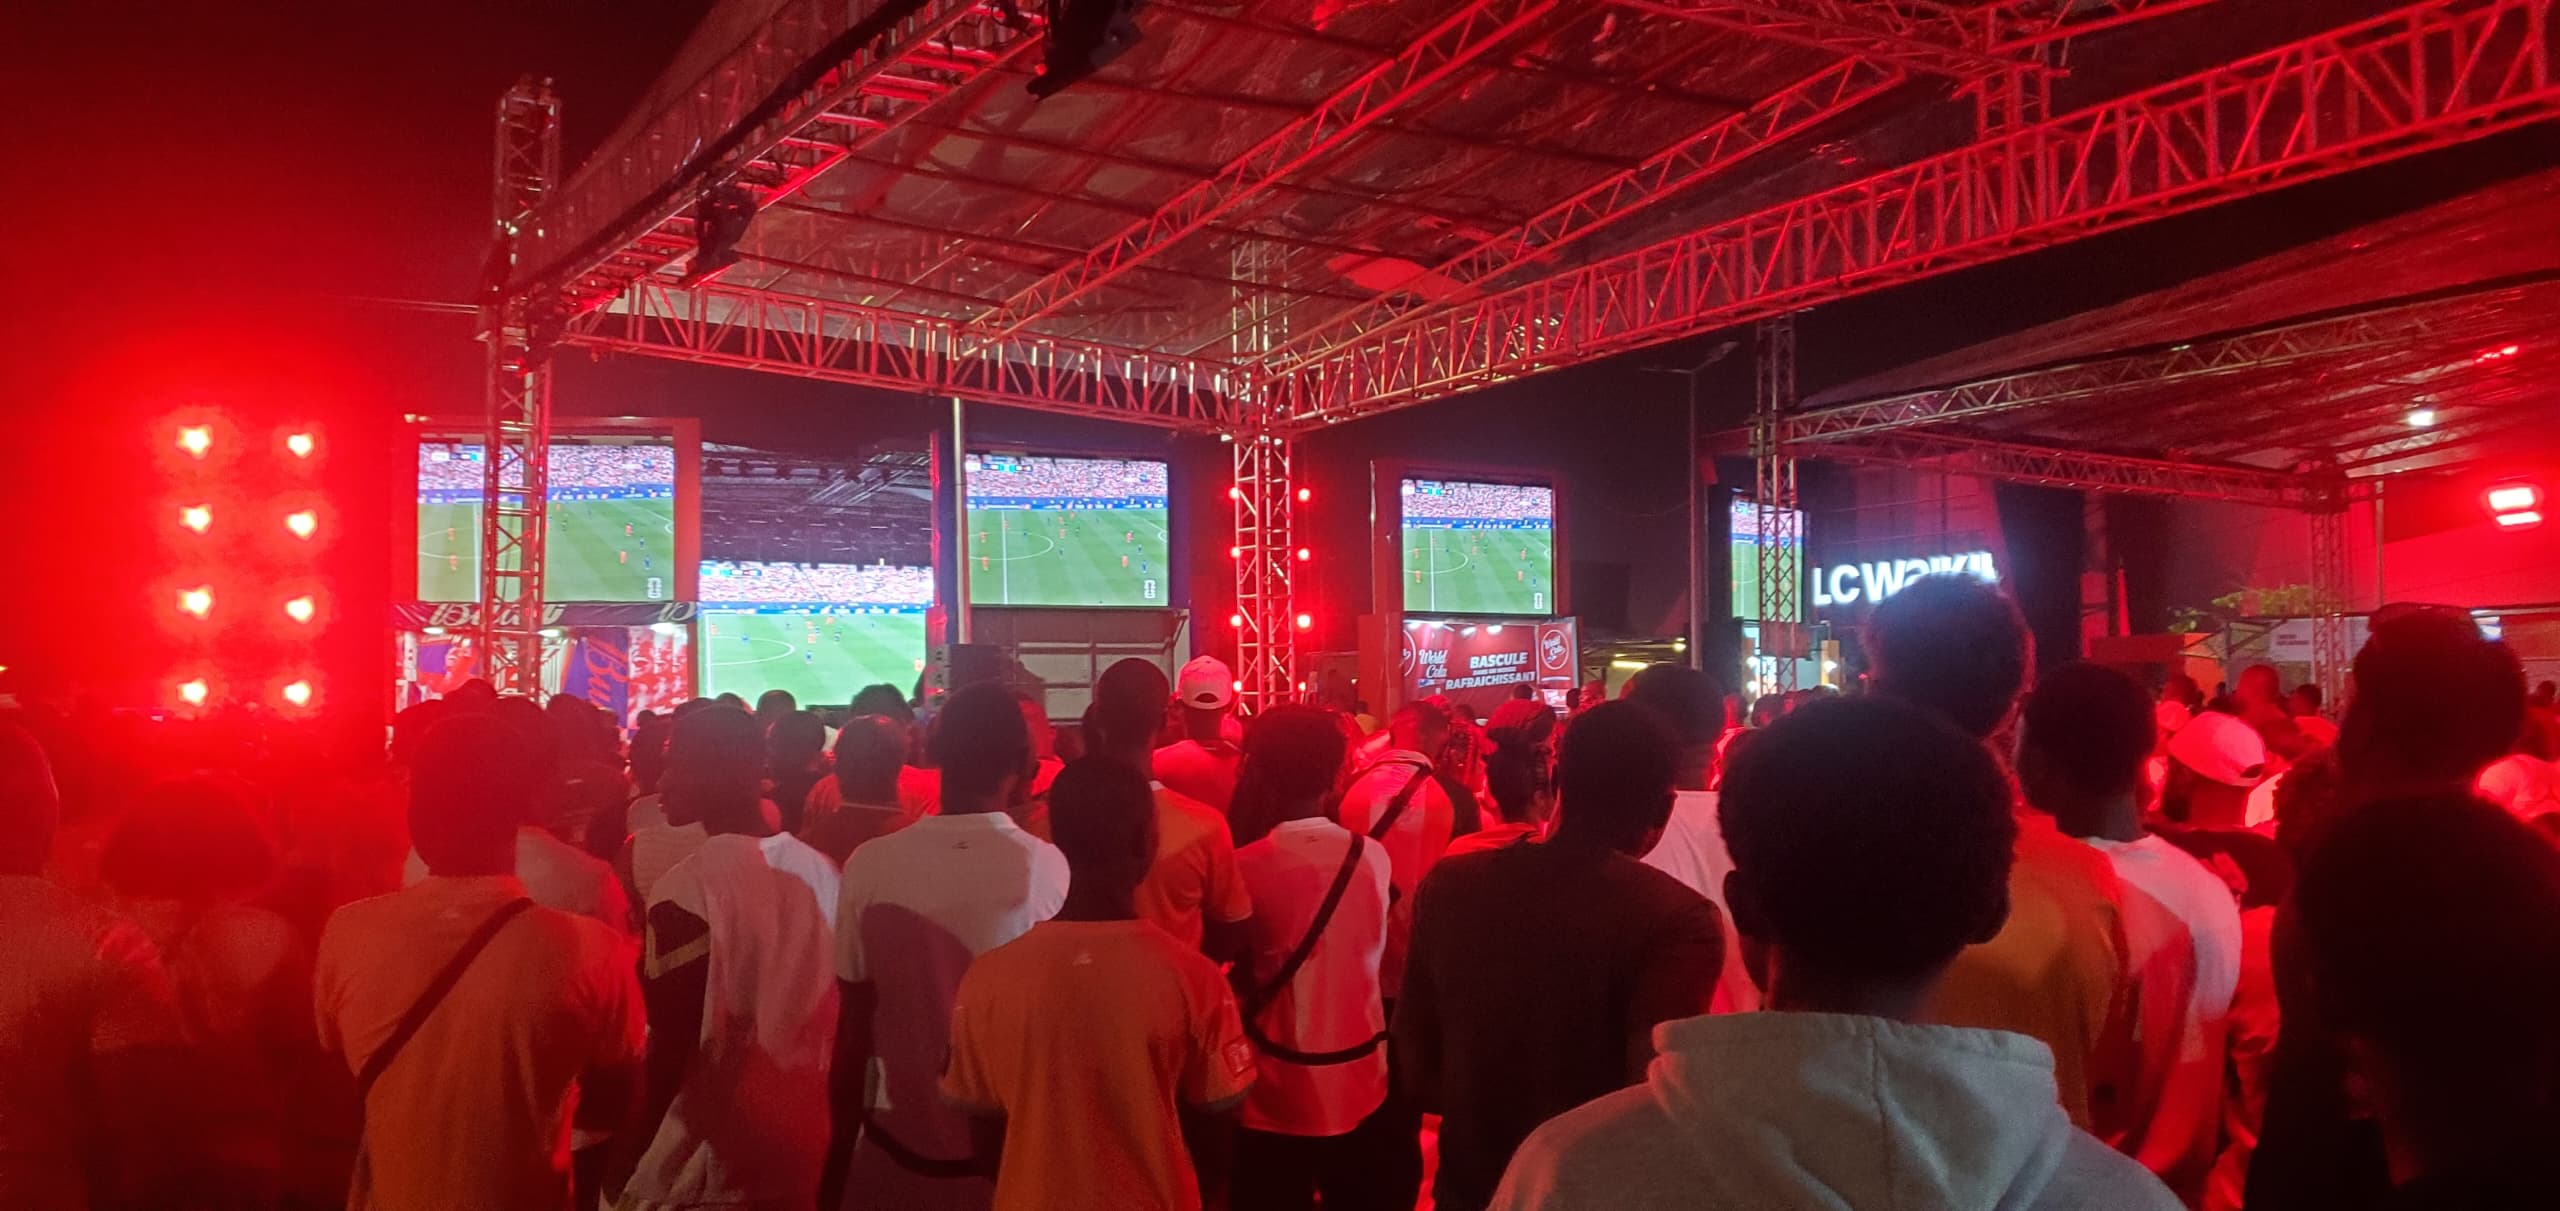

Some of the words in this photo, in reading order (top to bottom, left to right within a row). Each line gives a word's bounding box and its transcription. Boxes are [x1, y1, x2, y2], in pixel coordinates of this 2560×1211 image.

[1418, 648, 1448, 665] World
[1469, 652, 1529, 669] BASCULE
[1426, 665, 1448, 679] Cola
[1445, 671, 1536, 690] RAFRAICHISSANT
